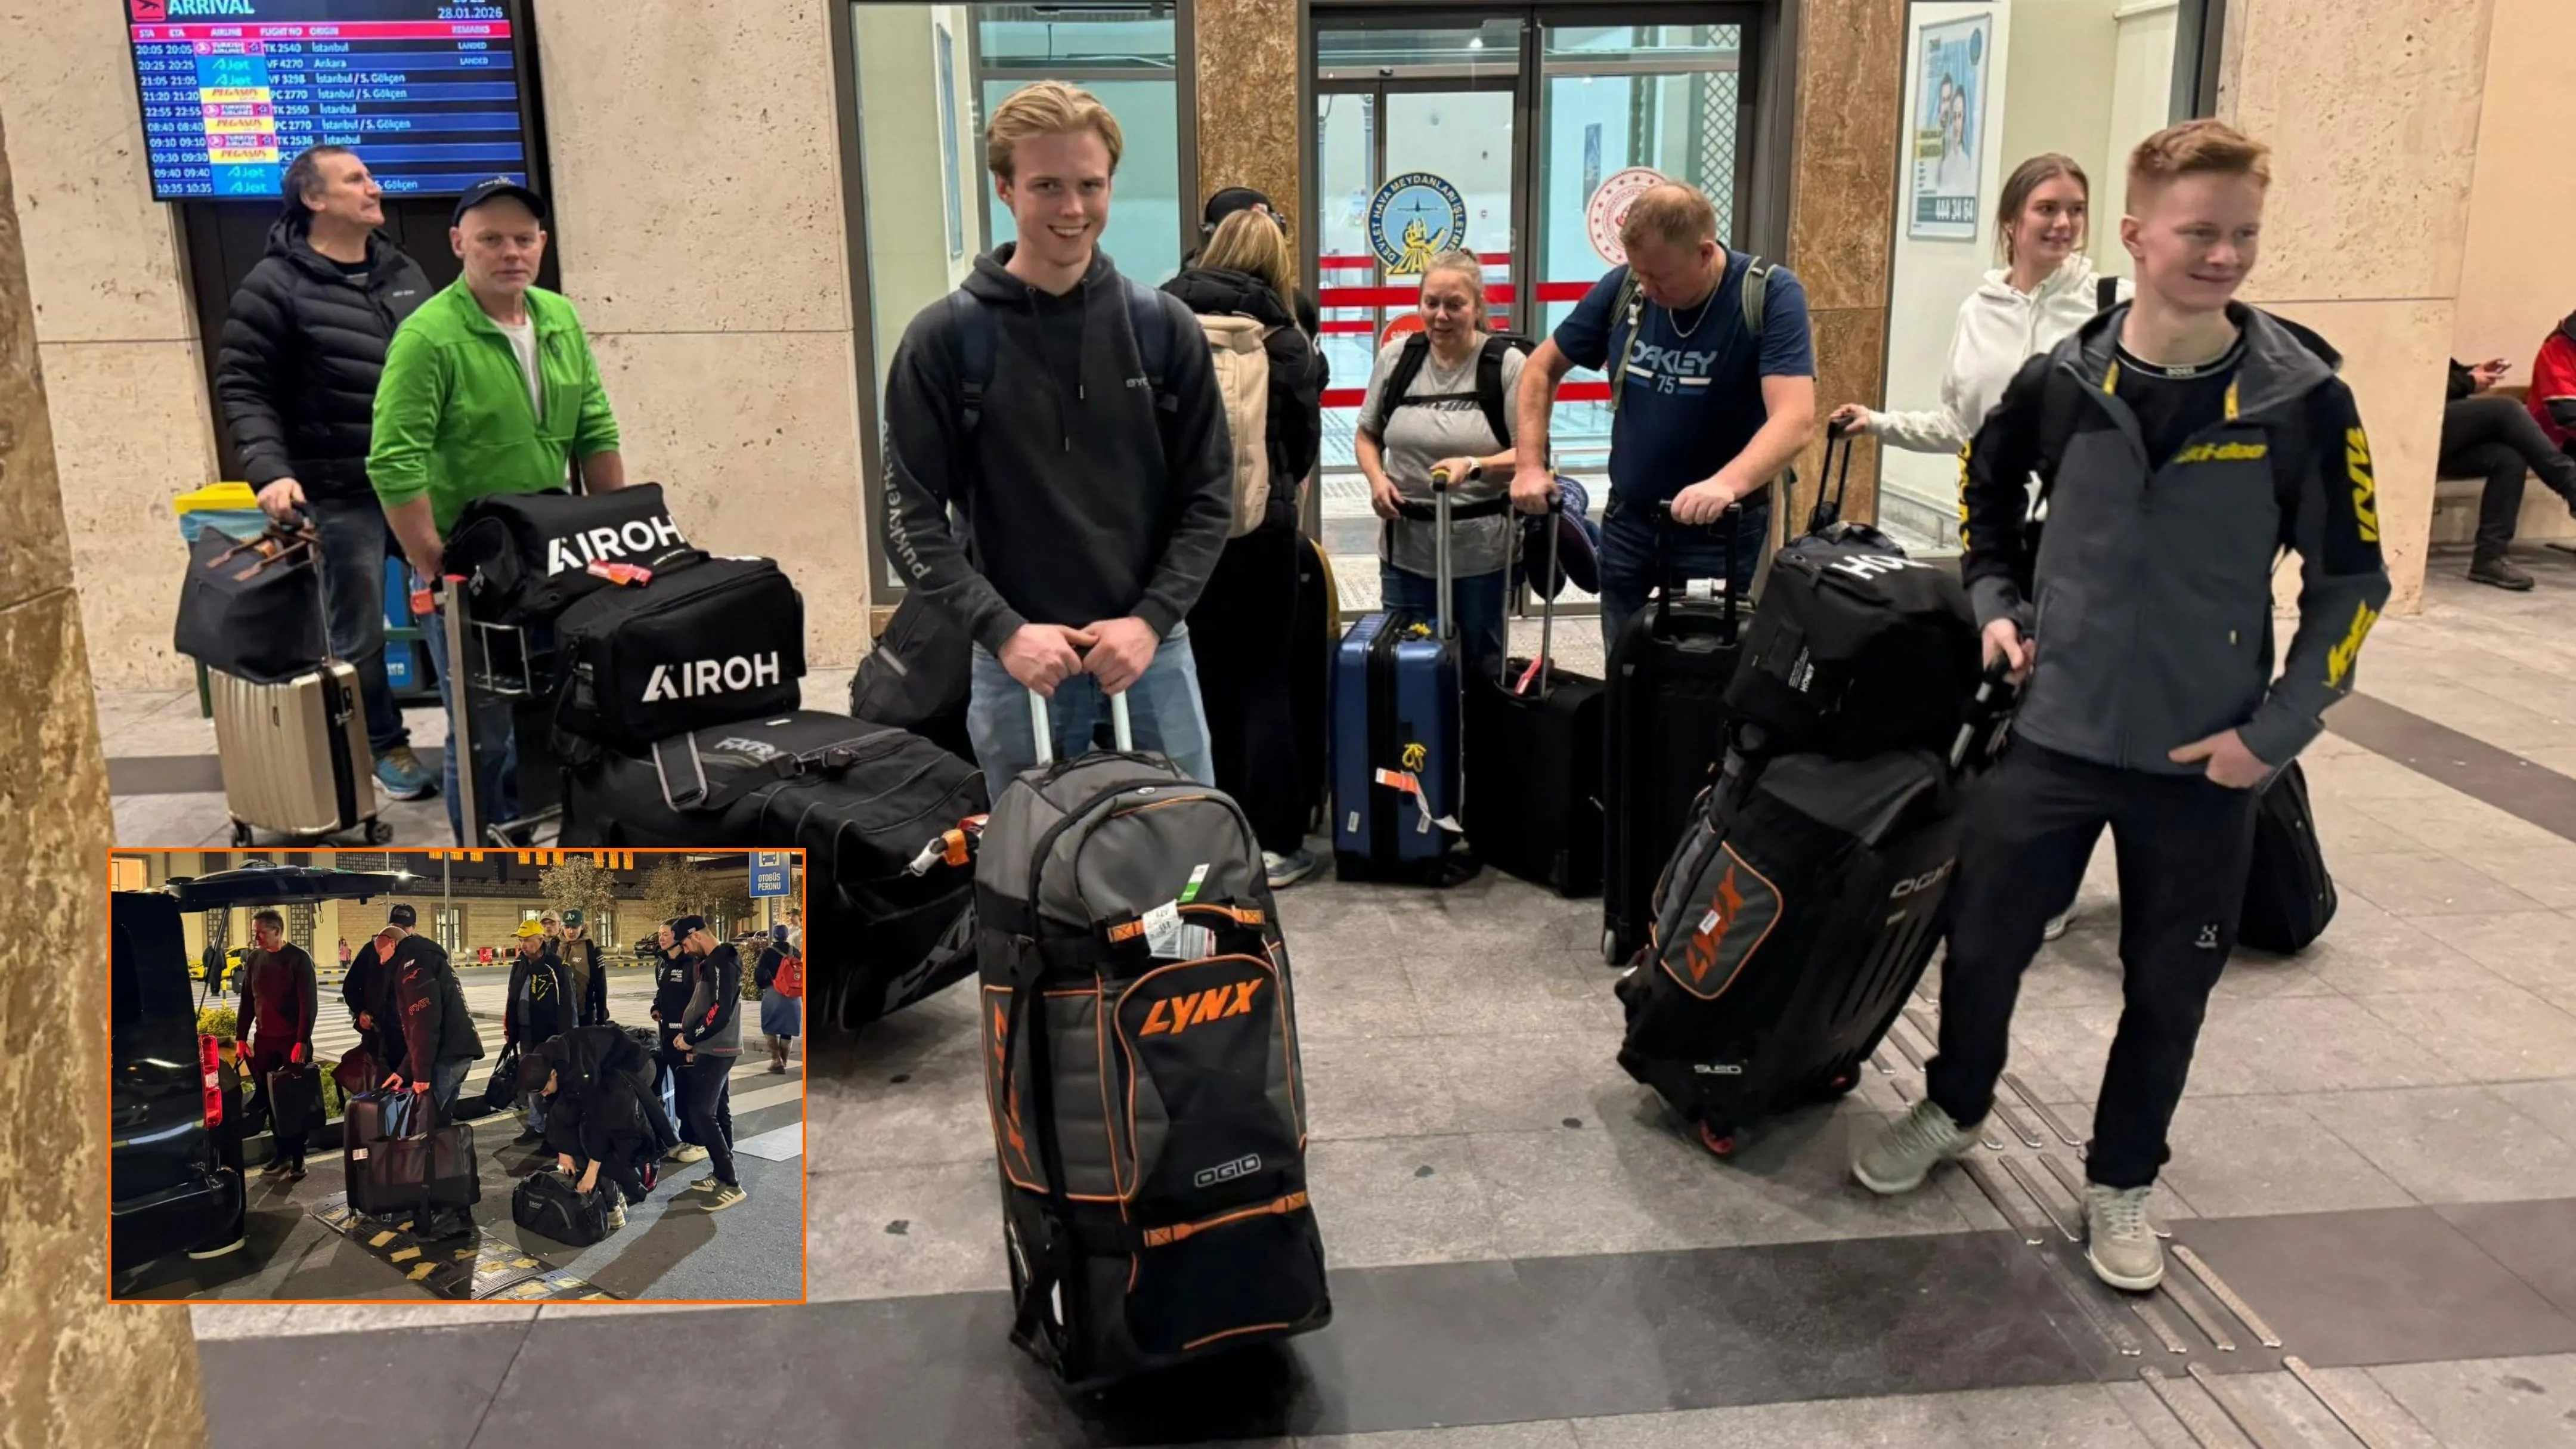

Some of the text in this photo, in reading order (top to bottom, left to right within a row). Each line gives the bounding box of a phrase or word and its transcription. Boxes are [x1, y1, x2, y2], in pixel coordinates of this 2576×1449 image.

[168, 0, 255, 15] ARRIVAL
[438, 7, 503, 19] 28.01.2026
[136, 45, 162, 54] 20:05
[166, 45, 192, 54] 20:05
[138, 61, 165, 70] 20:25
[168, 60, 194, 69] 20:25
[314, 60, 346, 68] Ankara
[141, 77, 168, 86] 21:05
[171, 76, 197, 85] 21:05
[143, 92, 170, 101] 21:20
[173, 91, 199, 100] 21:20
[145, 107, 172, 116] 22:55
[175, 107, 202, 116] 22:55
[148, 122, 175, 132] 08:40
[178, 122, 205, 131] 08:40
[289, 120, 312, 129] 2770
[150, 138, 176, 147] 09:10
[180, 138, 206, 147] 09:10
[152, 153, 179, 162] 09:30
[182, 153, 208, 162] 09:30
[154, 169, 181, 178] 09:40
[184, 168, 210, 177] 09:40
[157, 184, 183, 193] 10:35
[187, 184, 212, 193] 10:35
[1628, 340, 1718, 376] OAKLEY
[1657, 373, 1677, 394] 75
[548, 515, 686, 577] AIROH
[642, 651, 780, 702] AIROH
[758, 871, 781, 883] OTOBÜS
[758, 882, 781, 891] PERONU
[1138, 977, 1265, 1036] LYNX
[1194, 1153, 1261, 1188] OGIO
